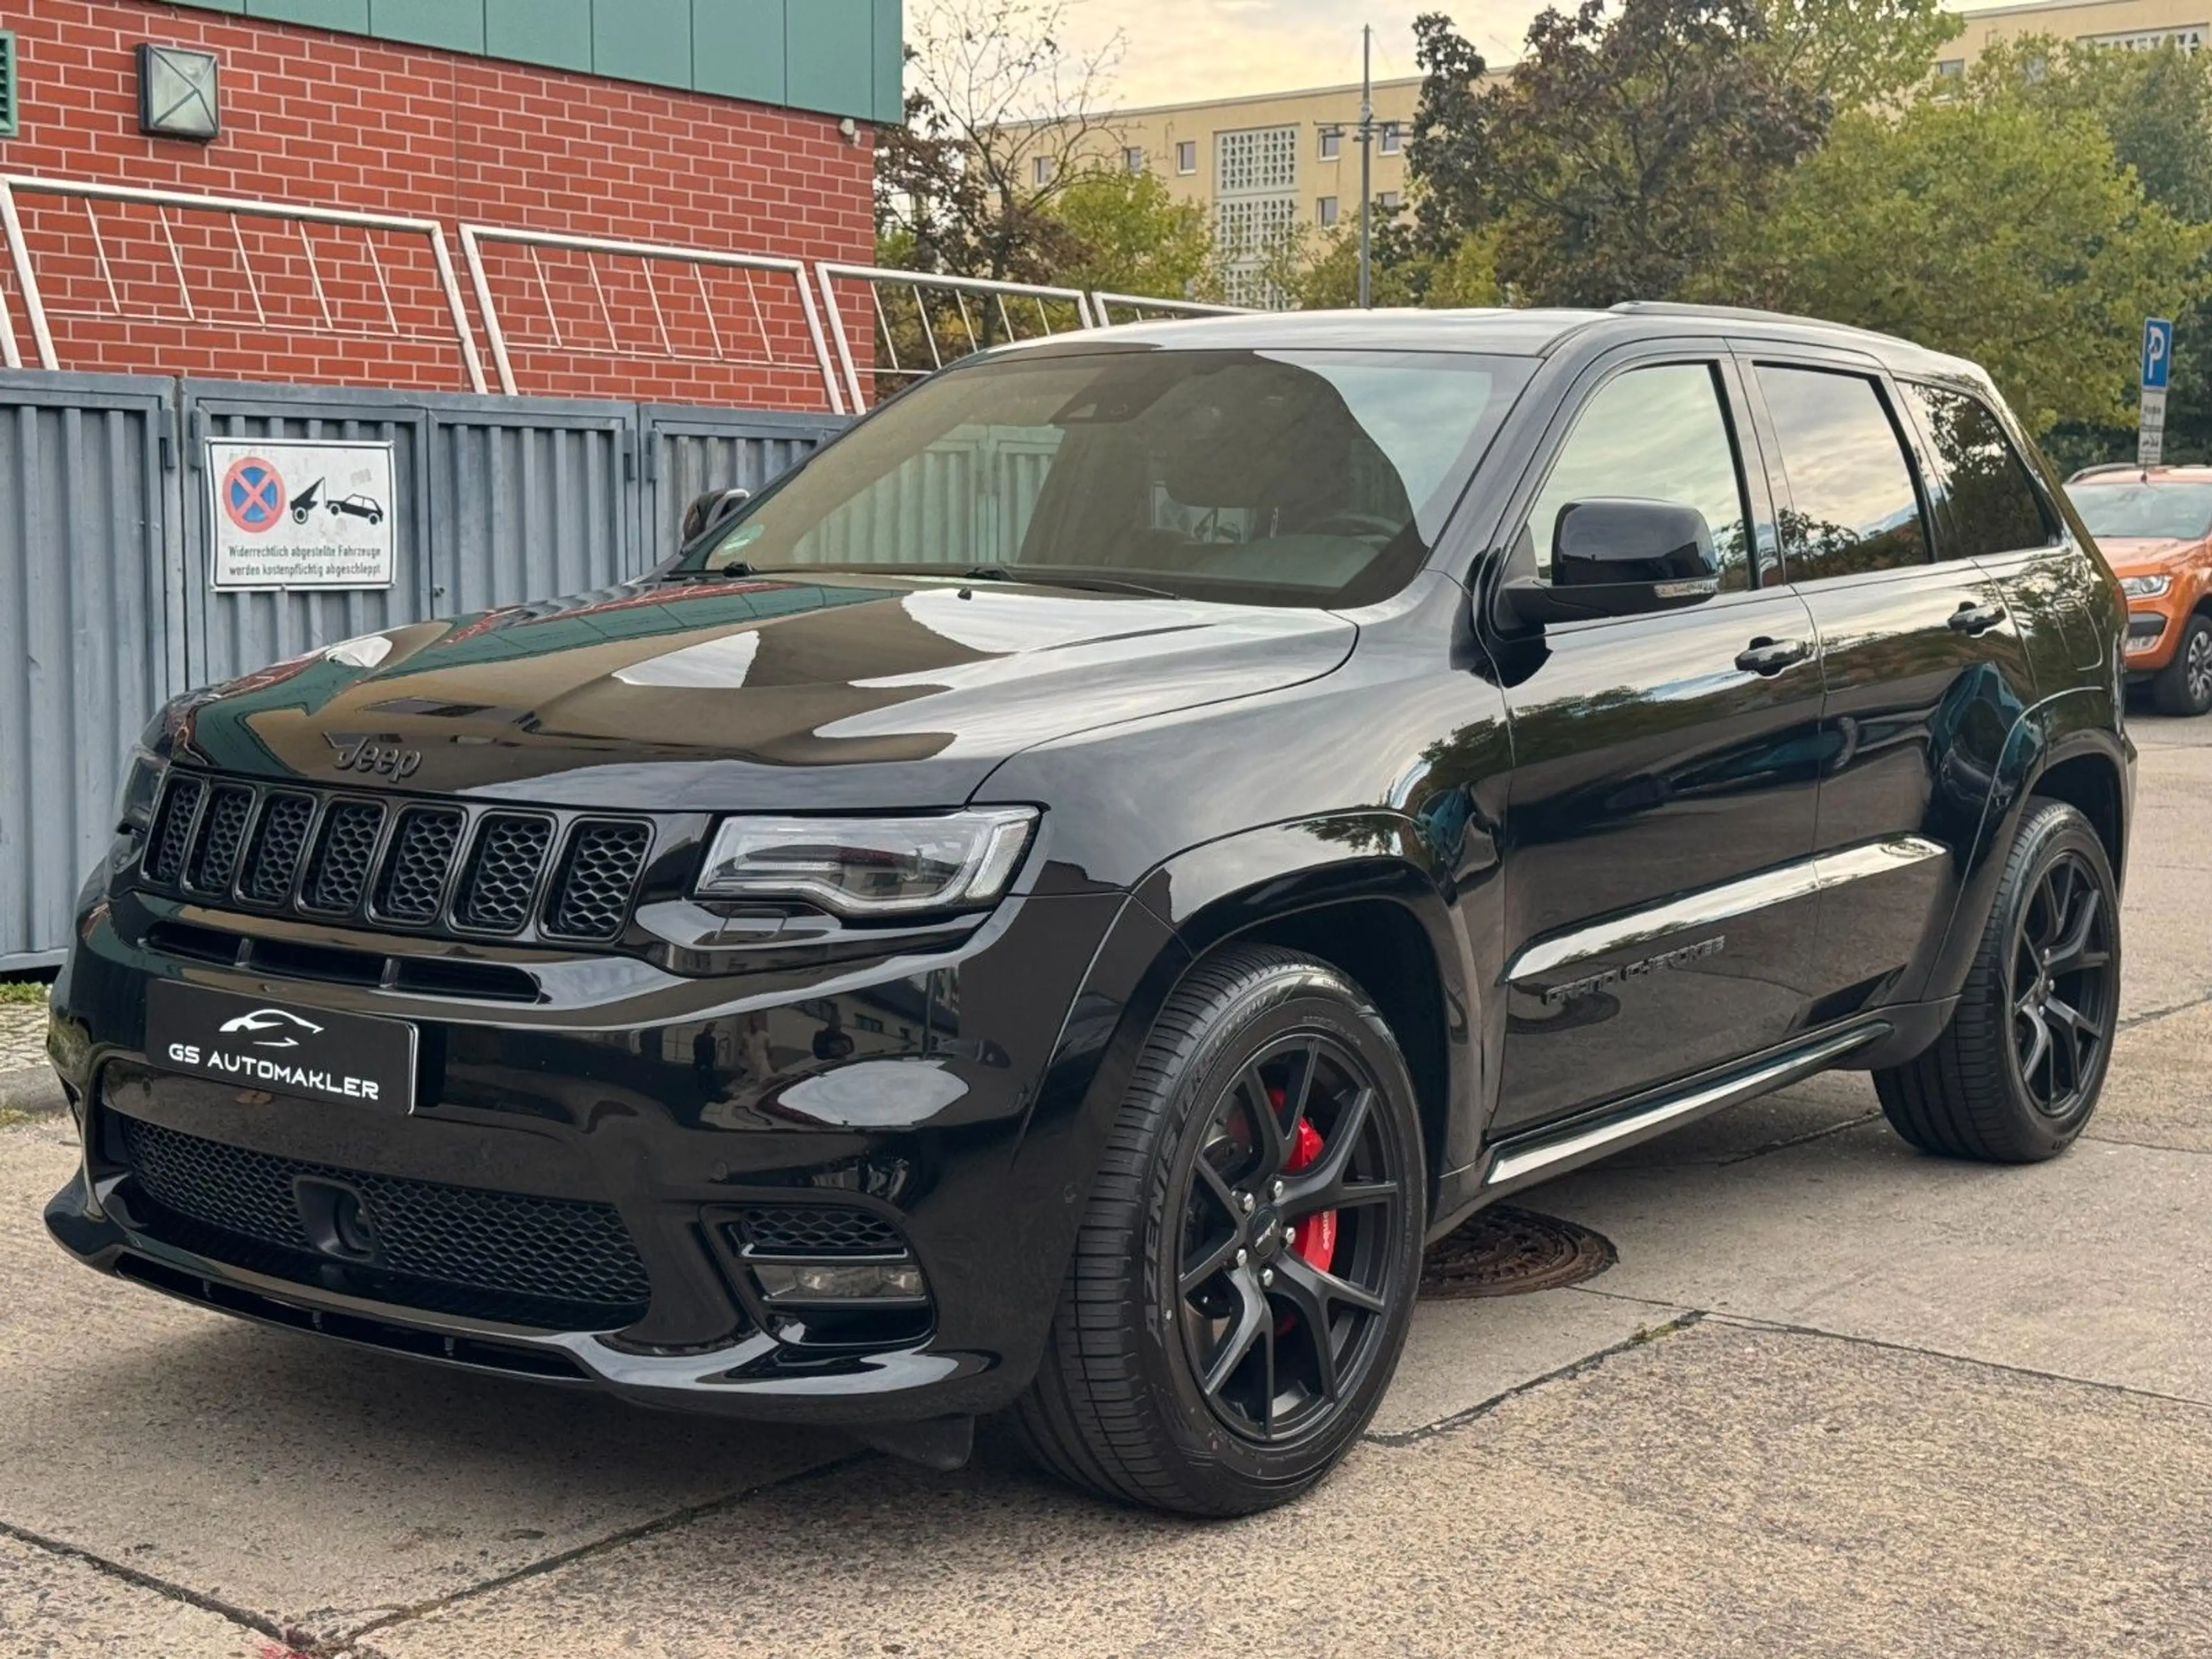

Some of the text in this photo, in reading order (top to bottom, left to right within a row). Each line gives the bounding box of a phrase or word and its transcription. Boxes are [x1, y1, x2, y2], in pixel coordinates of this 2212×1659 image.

[2147, 327, 2164, 379] P
[228, 544, 381, 560] Widerrechtlich abgestellte Fahrzeuge
[229, 562, 381, 578] werden kostenpflichtig abgeschleppt
[321, 730, 422, 784] Jeep
[169, 1043, 380, 1101] GS AUTOMAKLER
